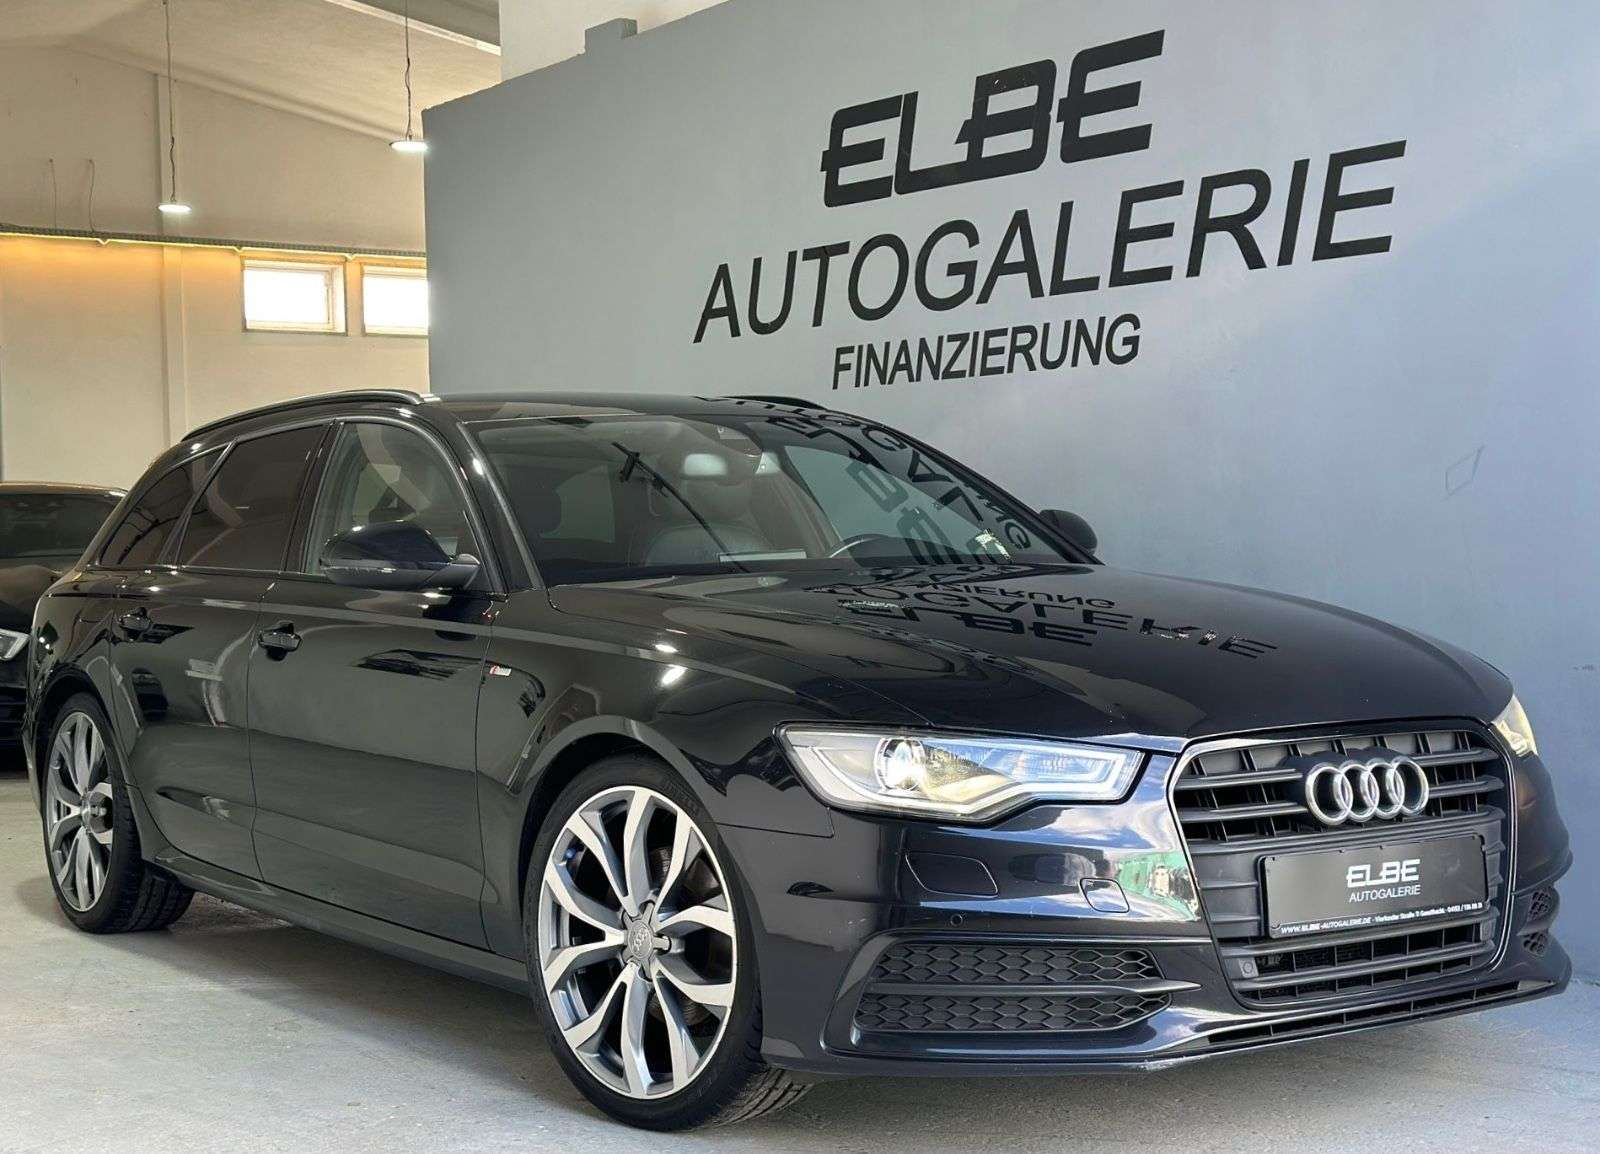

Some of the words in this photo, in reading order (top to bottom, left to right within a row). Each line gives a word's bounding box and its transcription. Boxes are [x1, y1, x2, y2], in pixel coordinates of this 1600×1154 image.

[821, 30, 1164, 207] ELBE
[693, 140, 1406, 344] AUTOGALERIE
[832, 313, 1141, 390] FINANZIERUNG
[1346, 858, 1421, 888] ELBE
[1349, 884, 1421, 903] AUTOGALERIE
